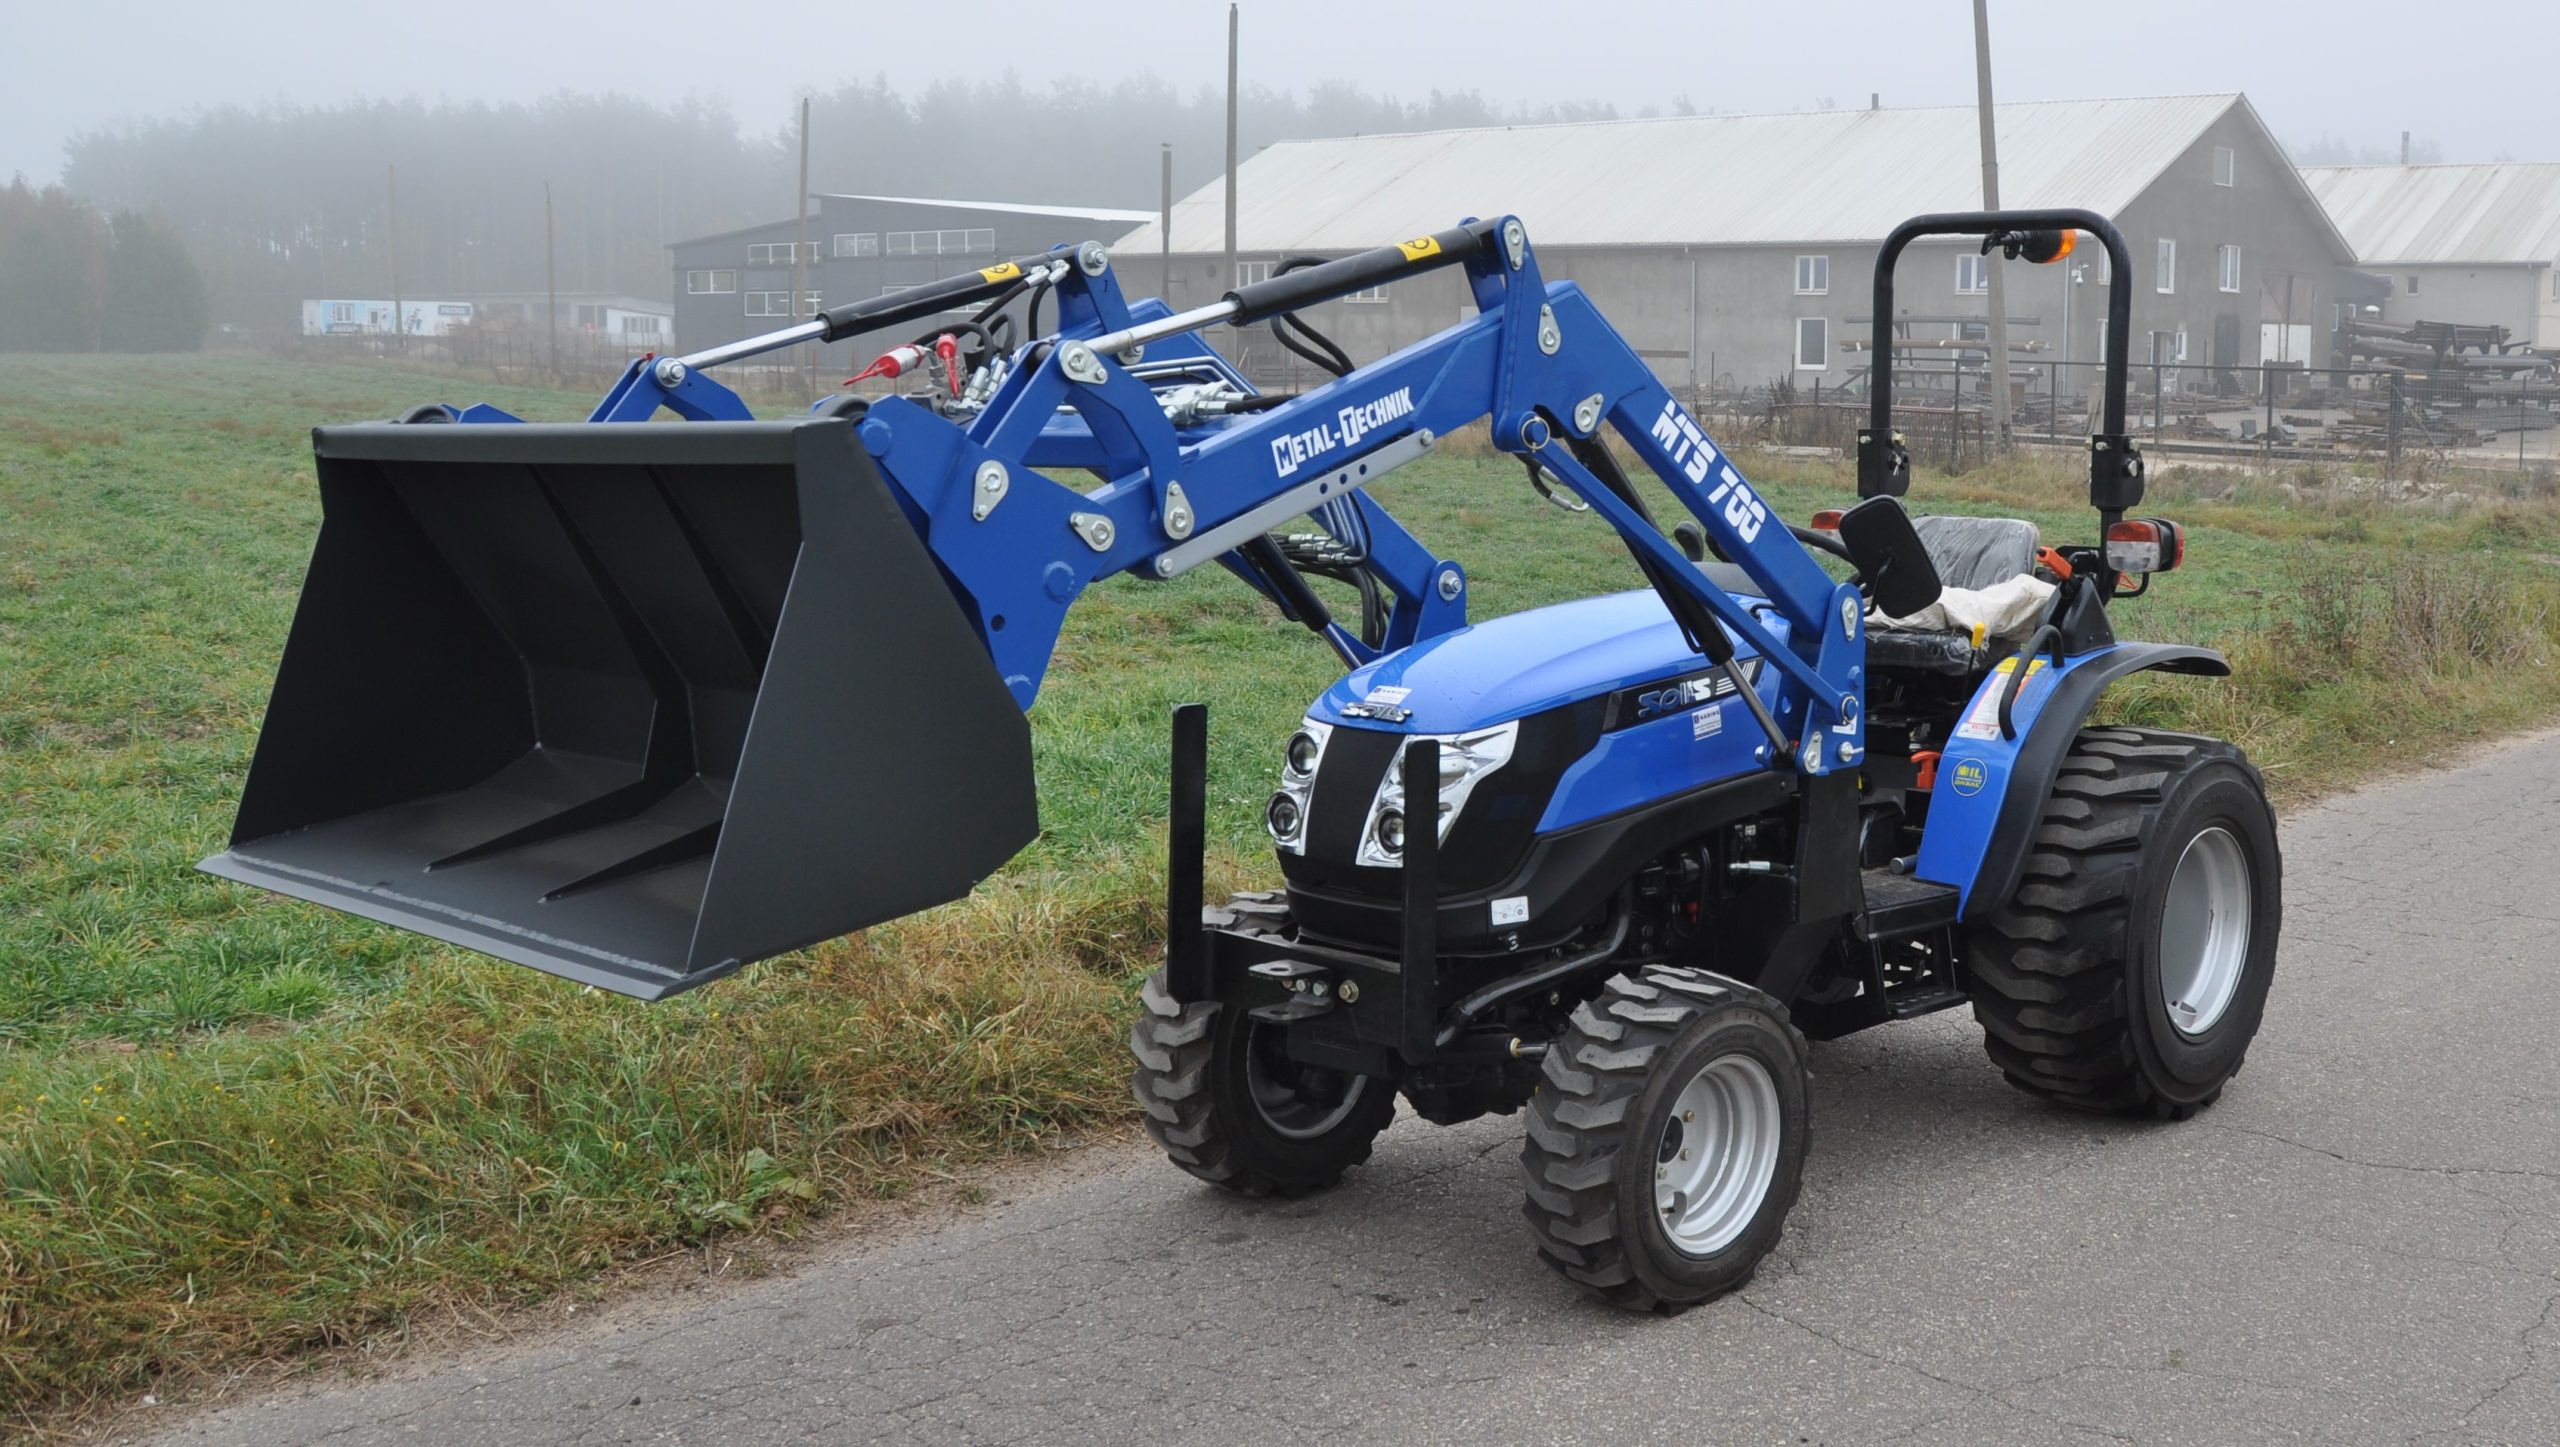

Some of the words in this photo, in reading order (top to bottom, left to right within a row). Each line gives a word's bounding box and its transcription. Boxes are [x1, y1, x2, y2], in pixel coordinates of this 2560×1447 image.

[1271, 386, 1414, 478] METAL-TECHNIK
[1651, 399, 1717, 484] MTS
[1708, 464, 1767, 544] 700
[1957, 766, 1981, 778] OIL
